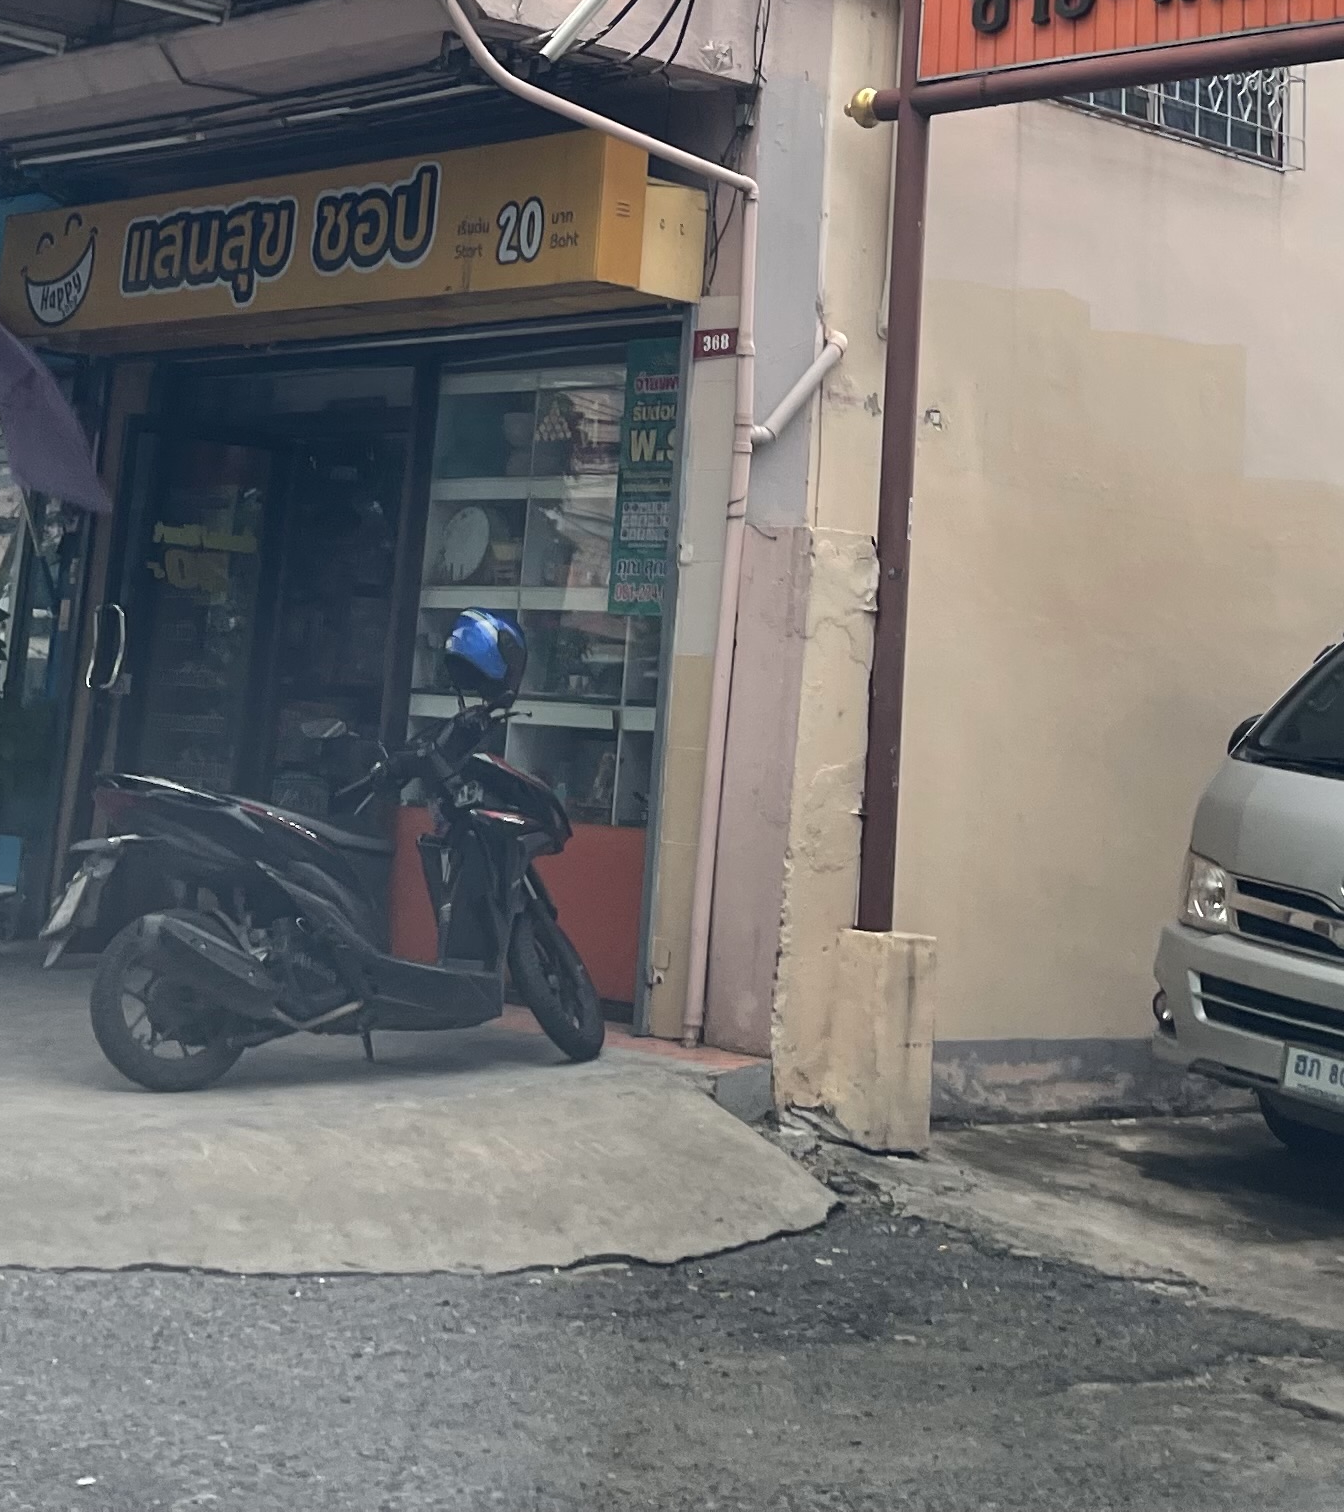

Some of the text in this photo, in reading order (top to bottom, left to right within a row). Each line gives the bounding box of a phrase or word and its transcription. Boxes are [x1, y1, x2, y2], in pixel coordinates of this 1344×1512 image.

[122, 162, 441, 306] แสนสุข ชอป
[496, 196, 544, 265] 20
[703, 333, 730, 352] 368
